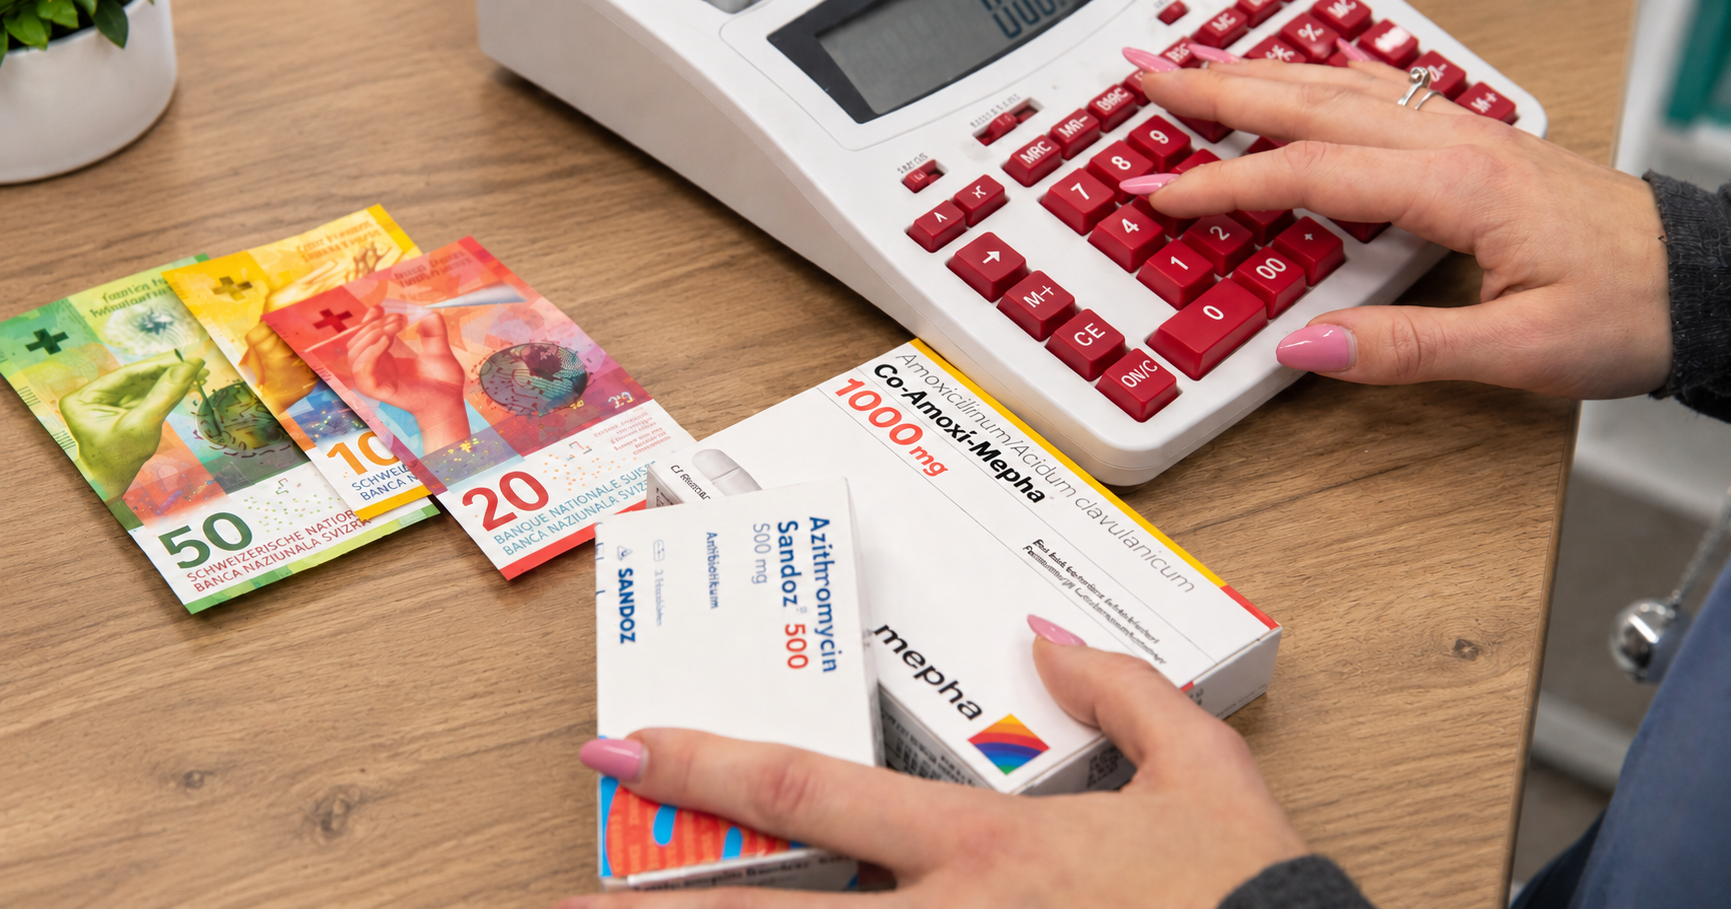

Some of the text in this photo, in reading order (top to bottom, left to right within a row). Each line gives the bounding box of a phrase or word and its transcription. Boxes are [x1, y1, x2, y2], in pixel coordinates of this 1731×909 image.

[1020, 141, 1052, 164] MRC
[1149, 130, 1170, 145] 9
[1111, 156, 1132, 170] 8
[1070, 182, 1090, 200] 7
[1122, 218, 1140, 235] 4
[1210, 225, 1231, 241] 2
[1170, 255, 1189, 271] 1
[1255, 257, 1287, 281] 00
[1023, 284, 1056, 309] M+
[1203, 304, 1224, 321] 0
[1074, 321, 1106, 348] CE
[1121, 359, 1158, 389] ON/C
[835, 378, 949, 477] 1000 mg
[874, 364, 1046, 503] Co-Amoxi-Mepha
[326, 431, 400, 475] 10
[360, 478, 407, 501] BANCA
[462, 471, 549, 532] 20
[493, 512, 550, 545] BANQUE
[549, 479, 621, 518] NATIONALE
[502, 530, 549, 556] BANCA
[548, 497, 619, 534] NAZIUNALA
[158, 512, 253, 569] 50
[187, 531, 305, 582] SCHWEIZERISCHE
[1075, 497, 1195, 593] clavulanicum
[193, 569, 243, 593] BANCA
[243, 538, 322, 573] NAZIUNALA
[751, 559, 768, 584] mg
[618, 568, 635, 644] SANDOZ
[778, 521, 809, 669] Sandoz 500
[809, 516, 843, 673] Azithromycin
[873, 624, 983, 721] mepha
